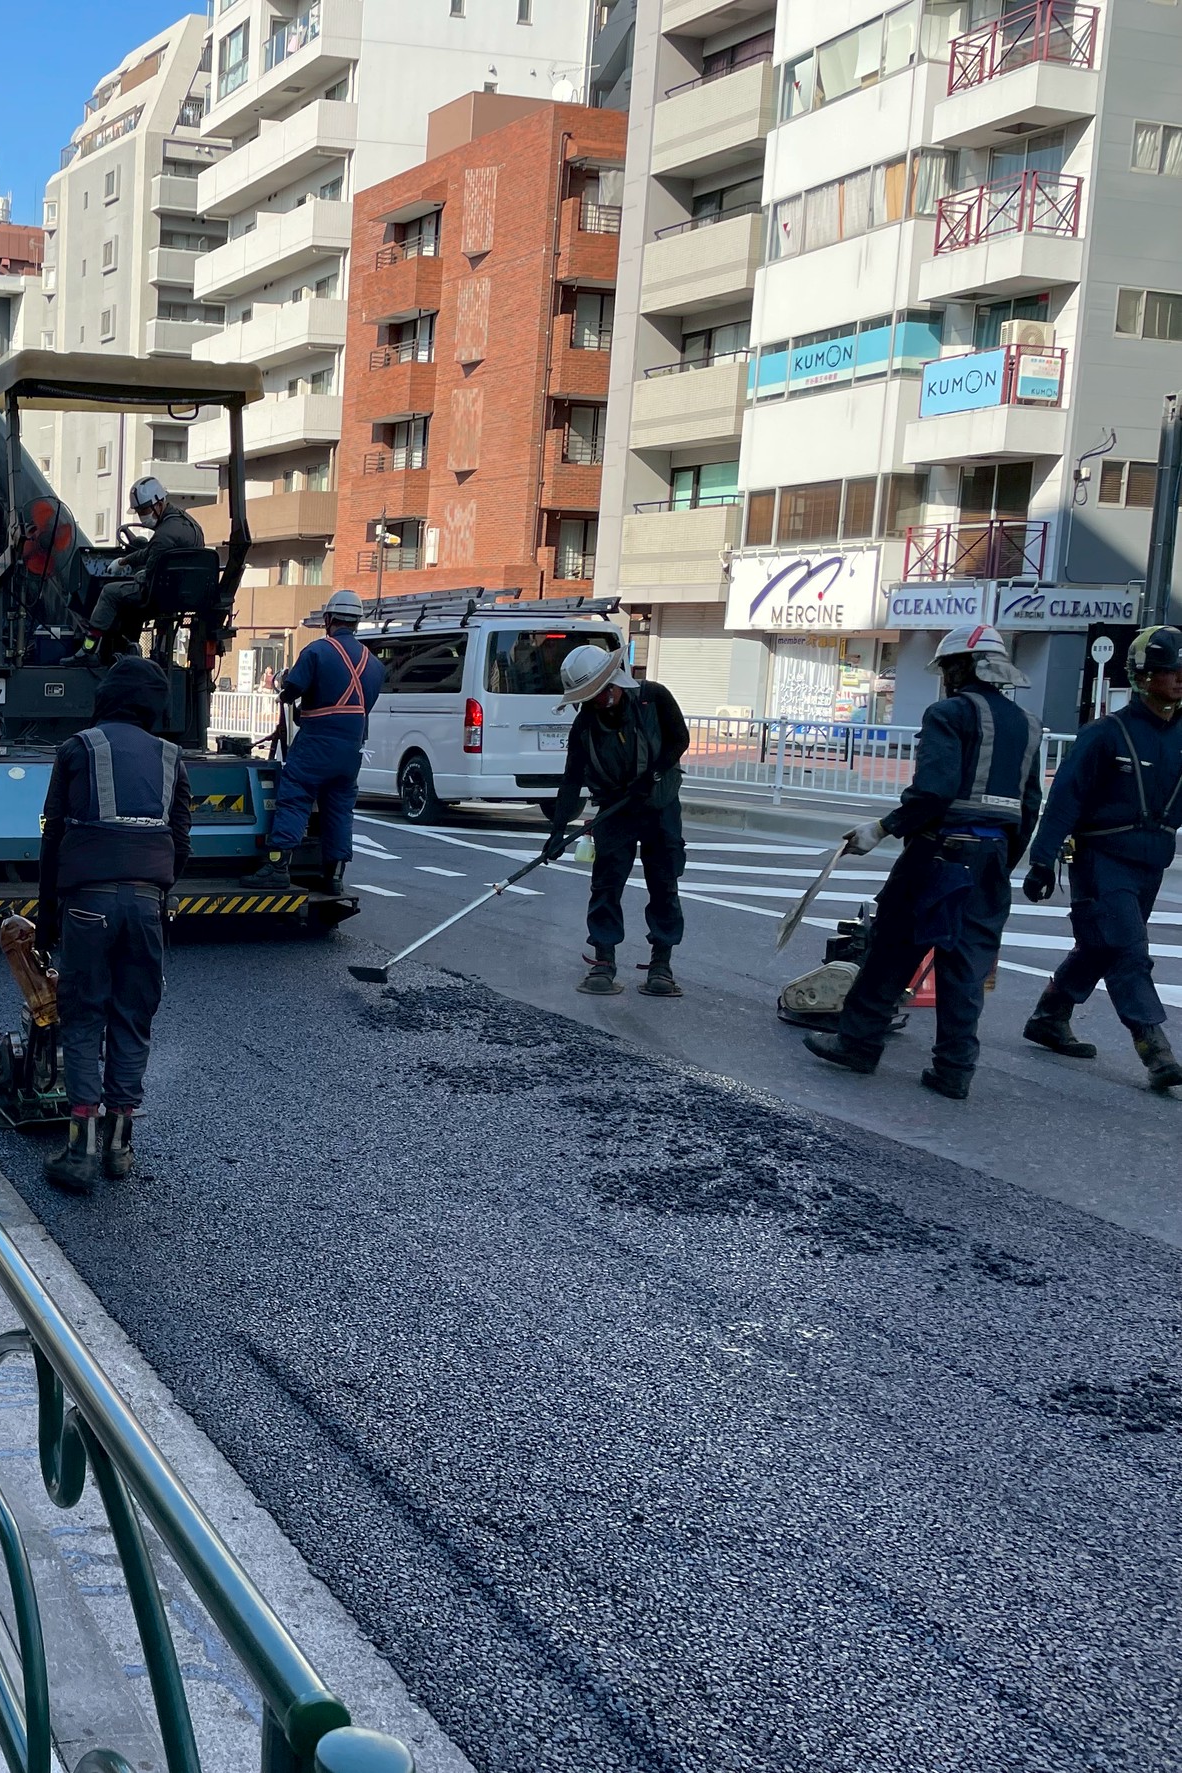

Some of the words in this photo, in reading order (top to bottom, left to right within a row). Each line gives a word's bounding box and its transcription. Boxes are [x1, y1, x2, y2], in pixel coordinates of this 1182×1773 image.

[794, 345, 853, 371] KUMON
[927, 370, 997, 397] KUMON
[1030, 388, 1058, 397] KUMON
[771, 604, 844, 623] MERCINE
[892, 597, 978, 616] CLEANING
[1013, 610, 1045, 619] MERCINE
[1049, 600, 1133, 618] CLEANING
[778, 636, 806, 645] member
